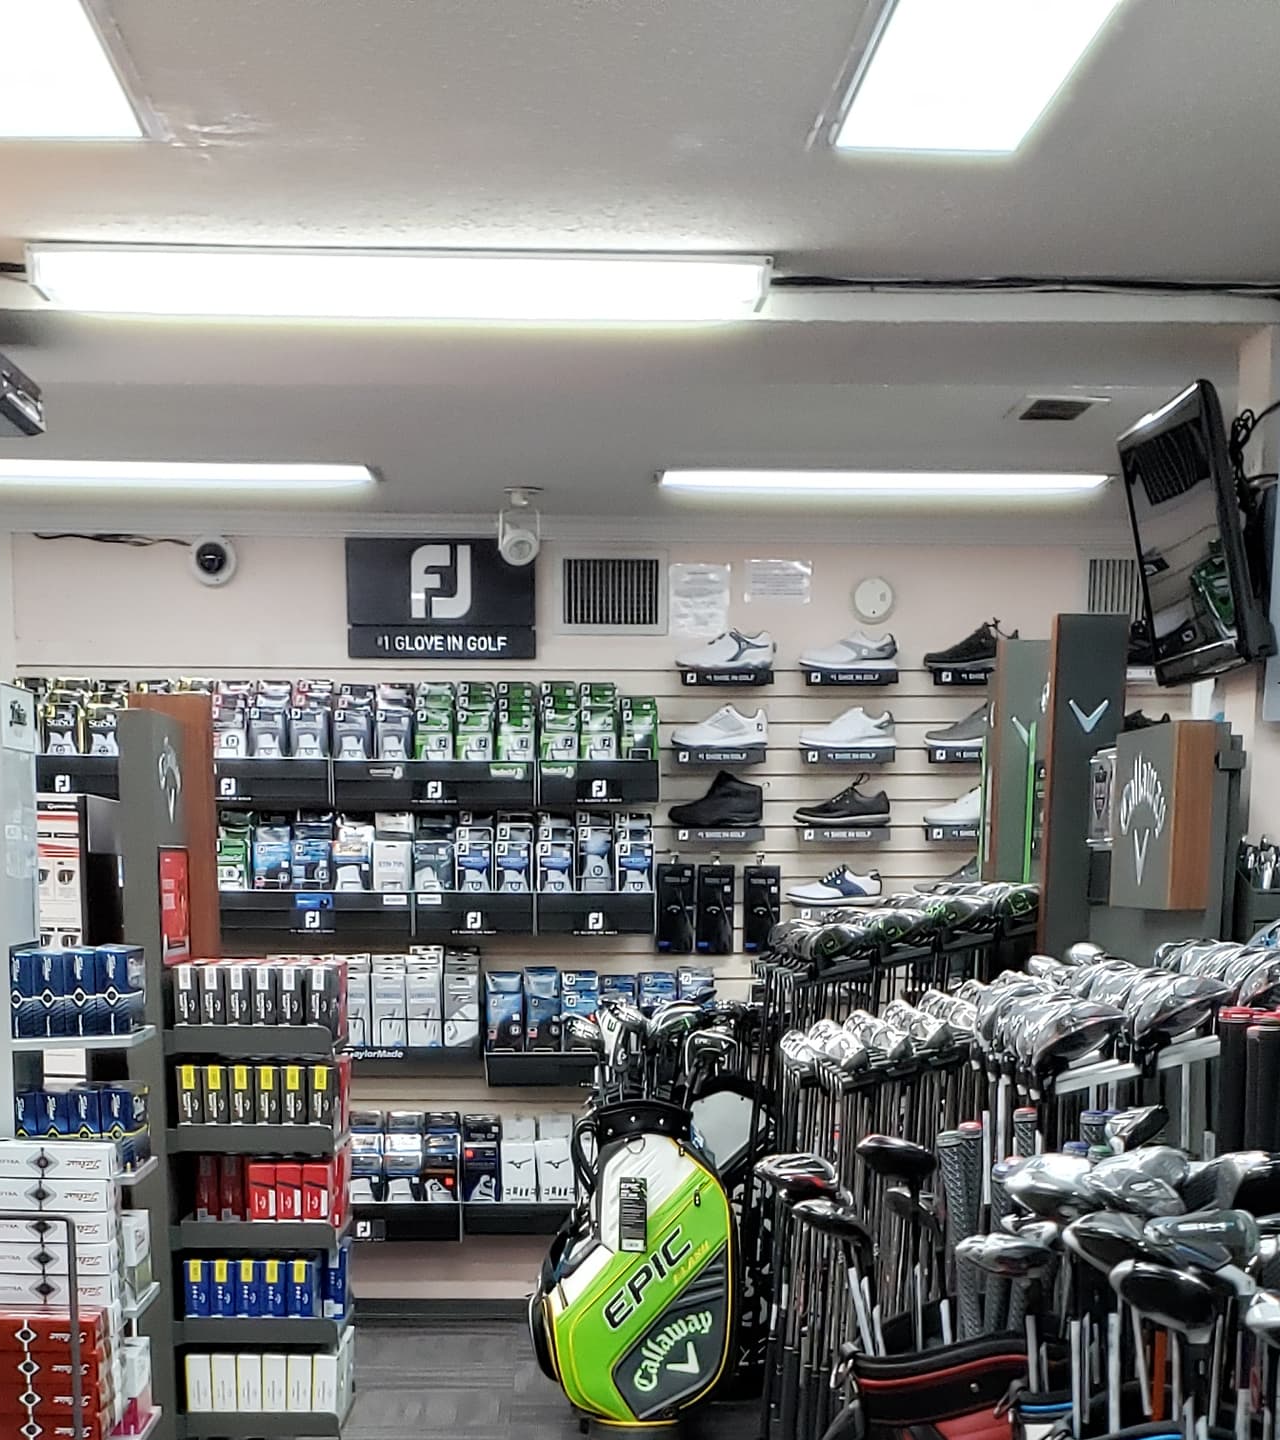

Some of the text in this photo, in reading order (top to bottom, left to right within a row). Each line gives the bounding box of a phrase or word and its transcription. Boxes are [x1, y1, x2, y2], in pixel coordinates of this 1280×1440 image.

[410, 544, 472, 619] FJ
[395, 635, 445, 651] GLOVE
[447, 635, 464, 651] IN
[467, 636, 508, 652] GOLF
[602, 1224, 693, 1331] EPIC
[633, 1309, 713, 1392] Callaway
